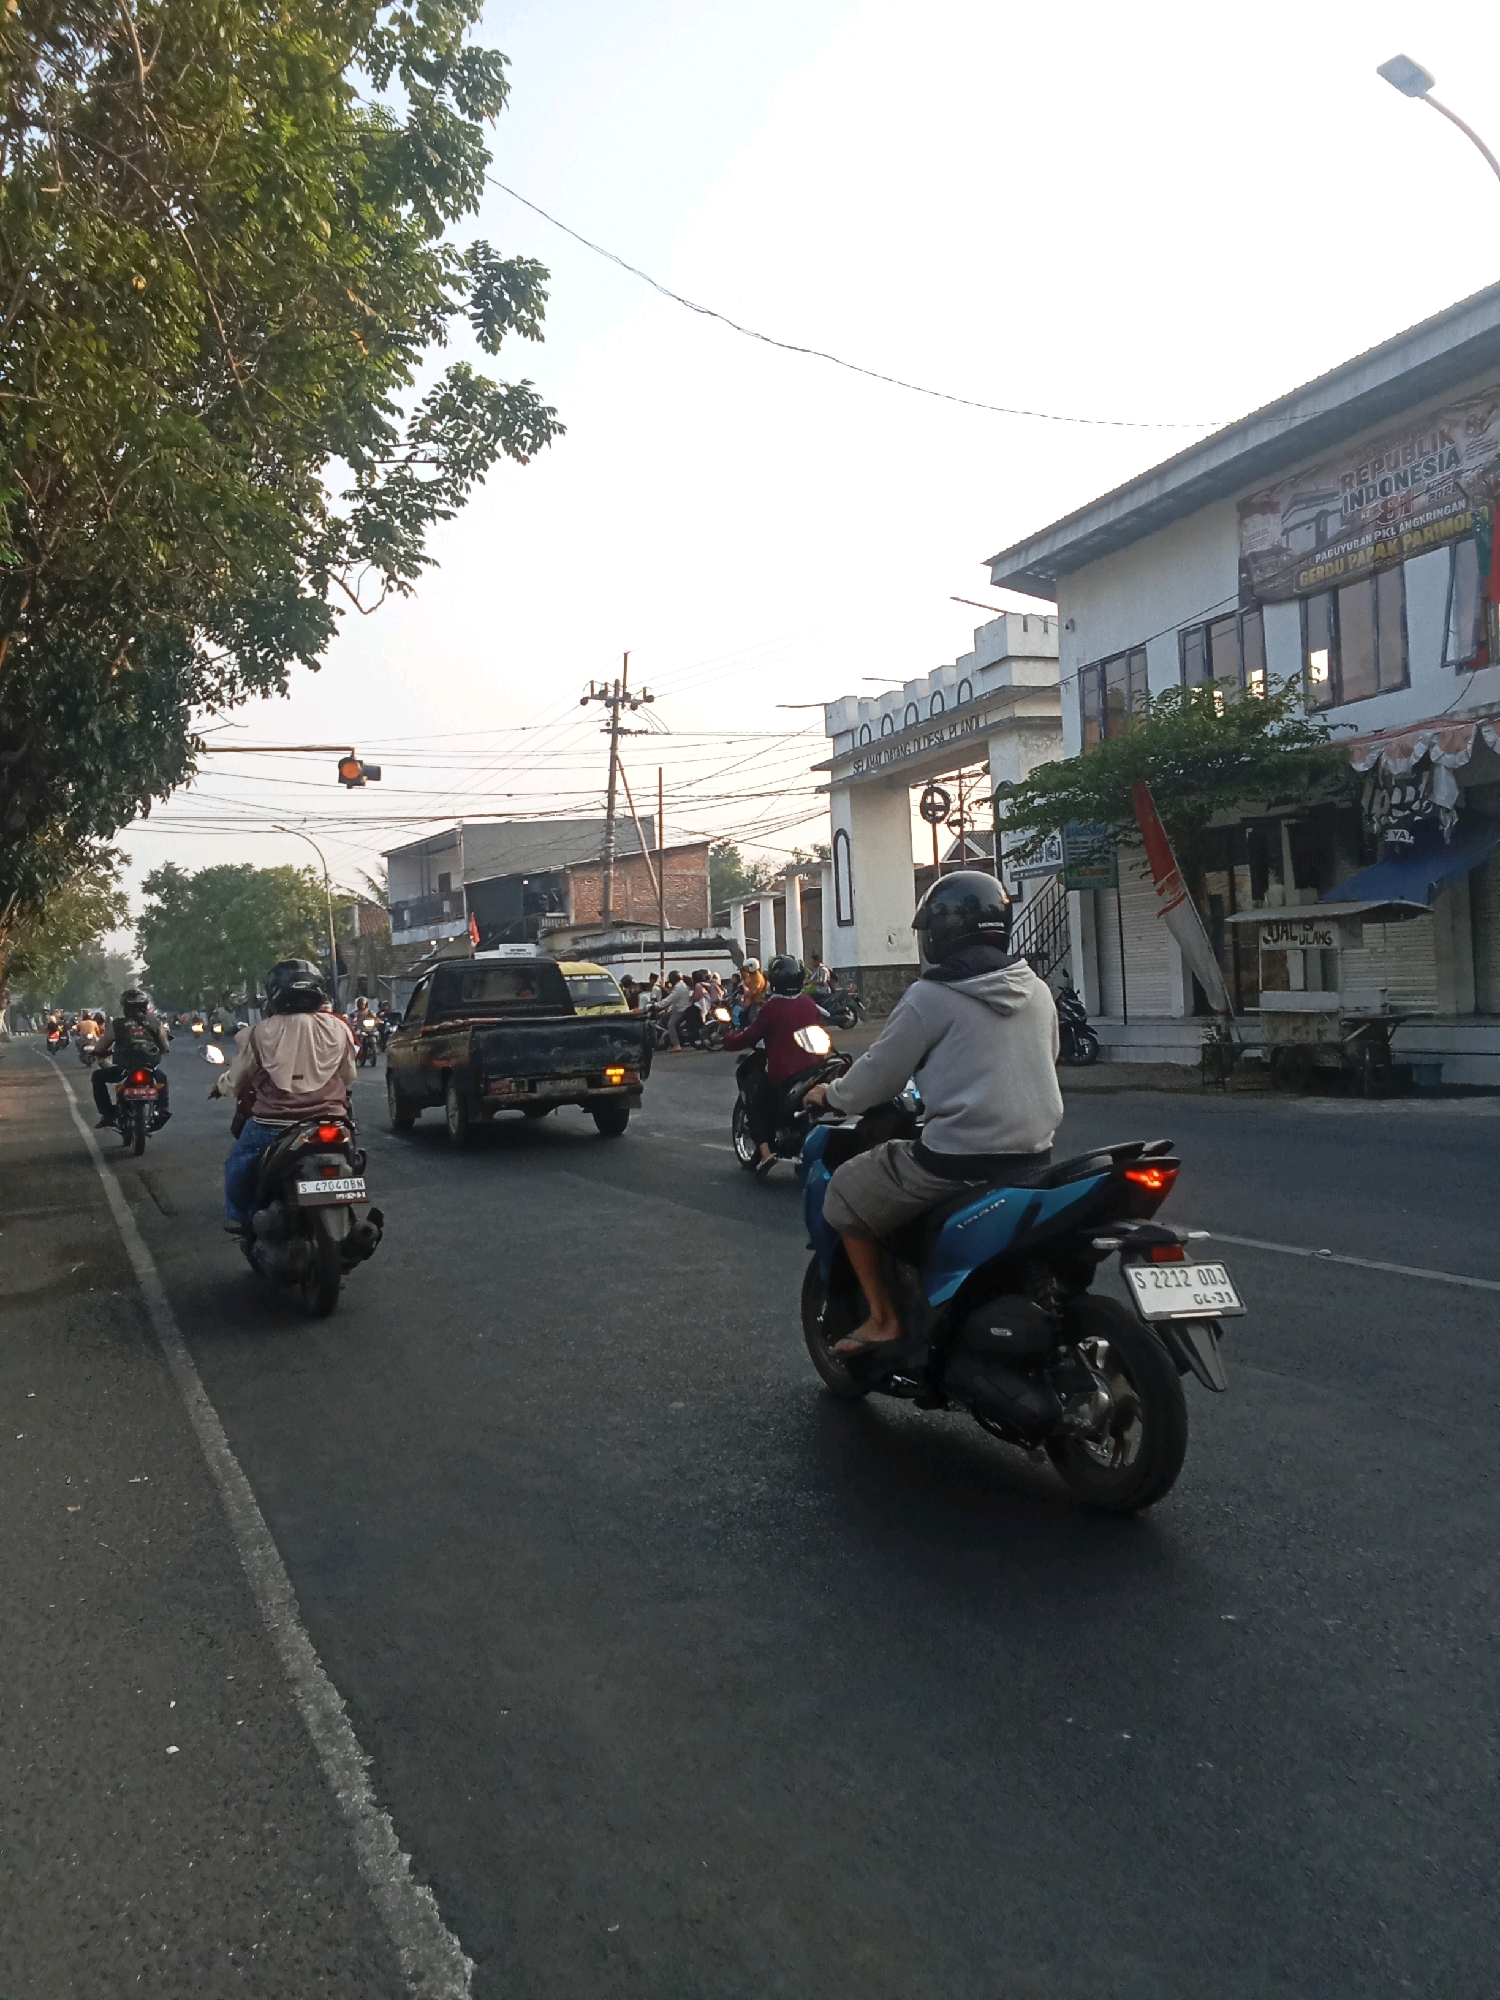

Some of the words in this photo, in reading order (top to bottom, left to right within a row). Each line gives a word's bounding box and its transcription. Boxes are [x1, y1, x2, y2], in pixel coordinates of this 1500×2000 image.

[1340, 428, 1457, 493] REPUBLIK
[1342, 447, 1461, 515] INDONESIA
[1315, 534, 1373, 564] PAGUYUBAN
[1373, 528, 1397, 546] PKL
[1398, 499, 1466, 534] ANGKRINGAN
[1299, 555, 1345, 588] GERDU
[1348, 537, 1399, 572] PAPAK
[853, 751, 882, 774] SELAMAT
[884, 742, 911, 764] DATANG
[923, 729, 945, 748] DESA
[1262, 921, 1298, 945] JUAL
[1298, 930, 1333, 947] ULANG
[301, 1183, 307, 1193] S
[1134, 1271, 1147, 1289] S
[1150, 1268, 1193, 1289] 2212
[1196, 1267, 1227, 1286] ODJ
